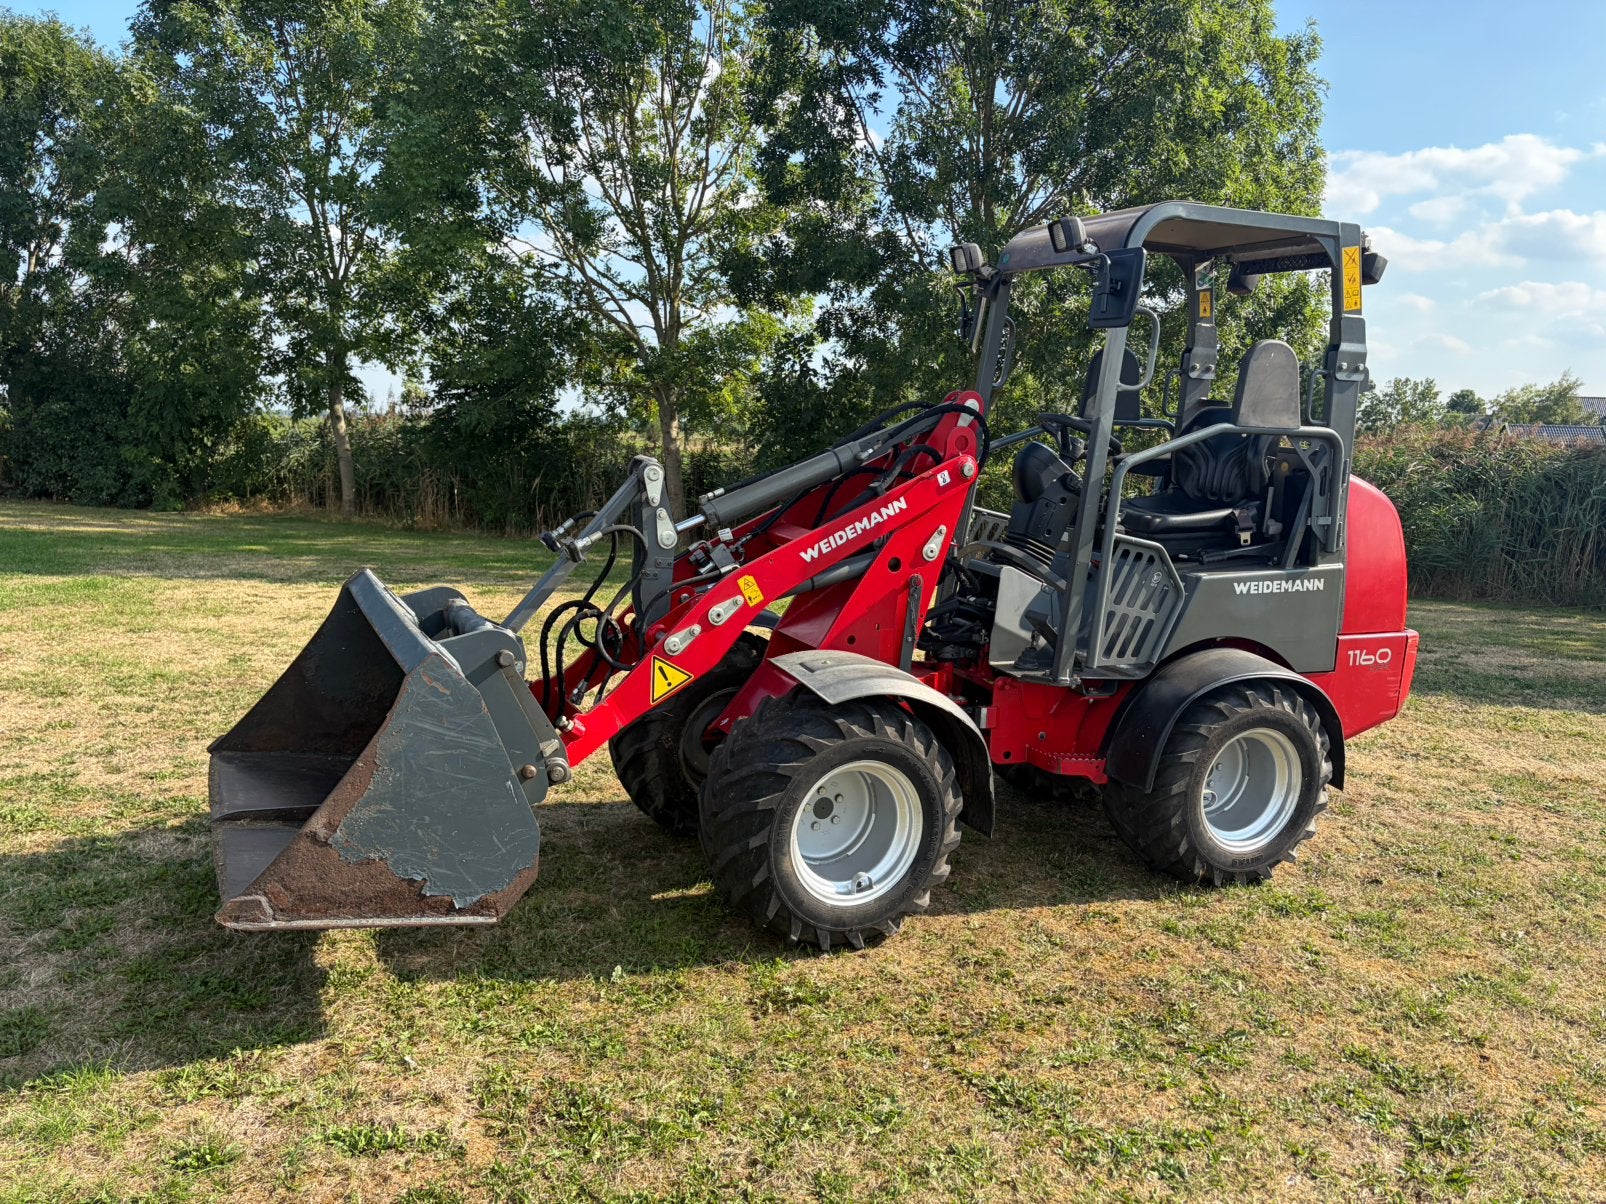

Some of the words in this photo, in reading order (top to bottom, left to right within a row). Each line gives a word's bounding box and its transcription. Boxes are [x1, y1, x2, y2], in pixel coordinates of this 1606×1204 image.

[799, 496, 907, 563] WEIDEMANN
[1233, 579, 1325, 595] WEIDEMANN
[1348, 648, 1392, 667] 1160
